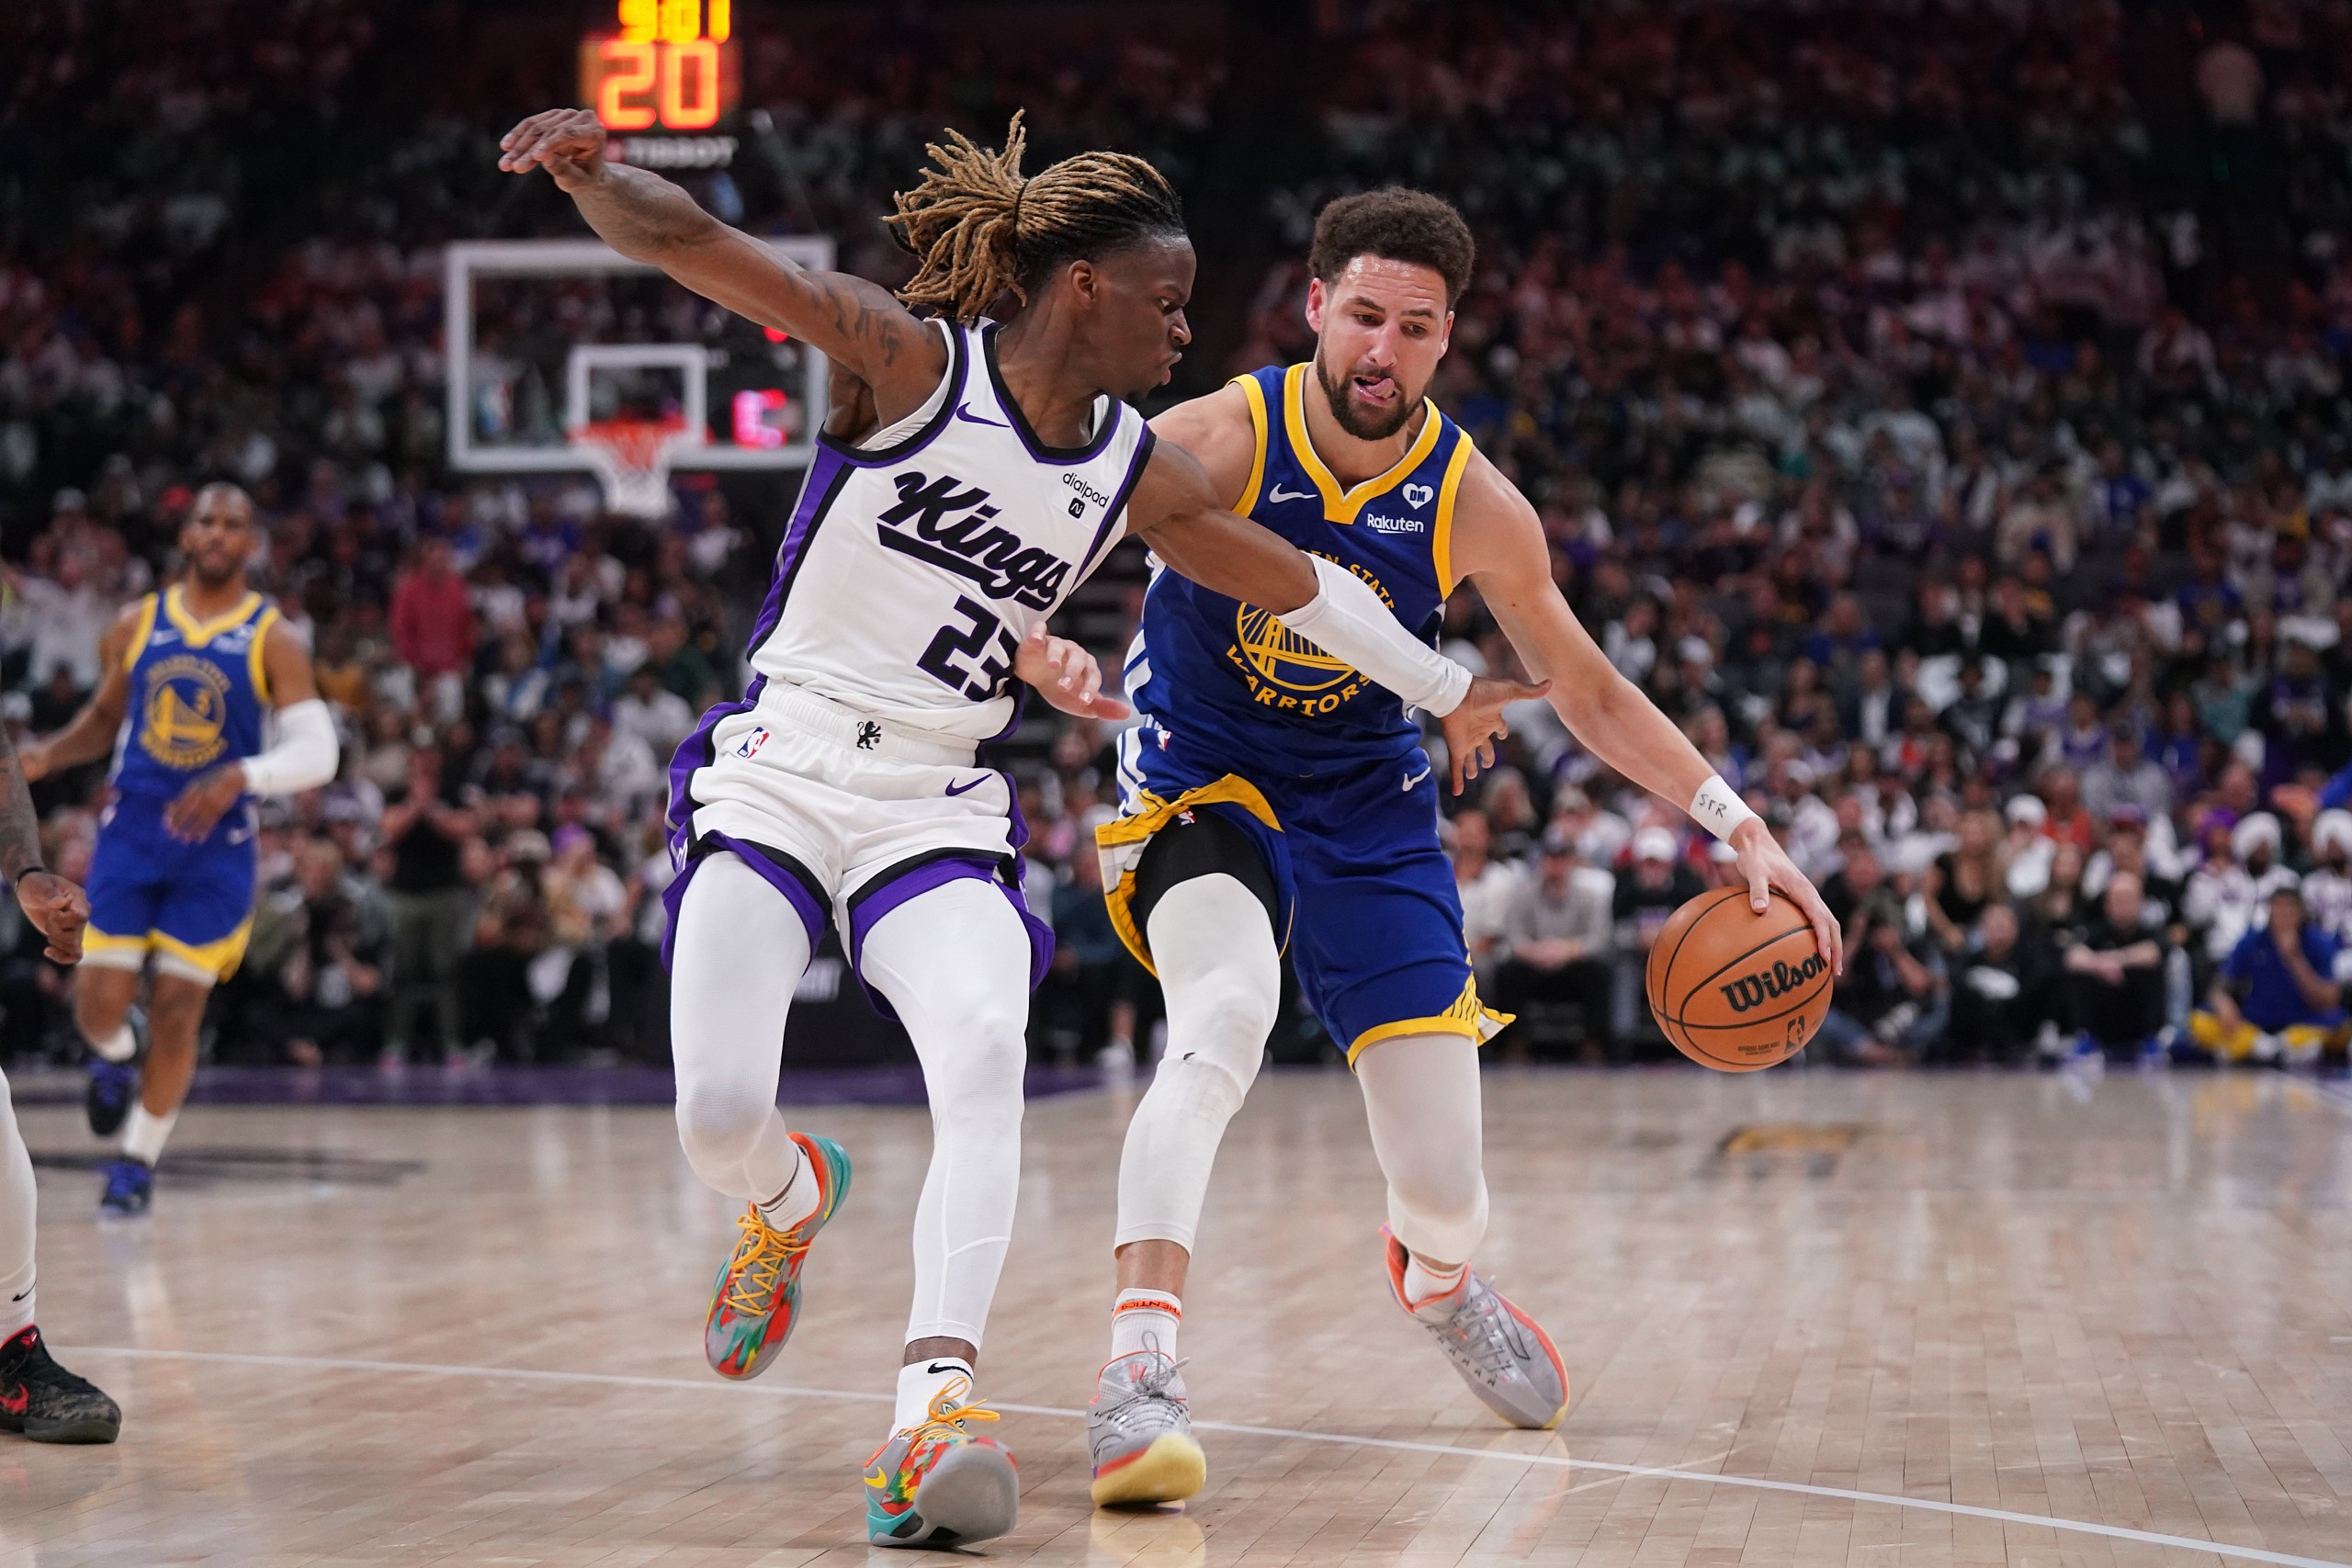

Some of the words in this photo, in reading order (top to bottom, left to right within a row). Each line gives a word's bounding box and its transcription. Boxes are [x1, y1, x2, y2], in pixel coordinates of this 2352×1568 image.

[598, 37, 719, 130] 20
[1063, 472, 1110, 508] dialpad
[1409, 490, 1426, 502] DM
[876, 471, 1072, 612] Kings
[1367, 513, 1424, 533] Rakuten
[1719, 953, 1828, 1012] Wilson
